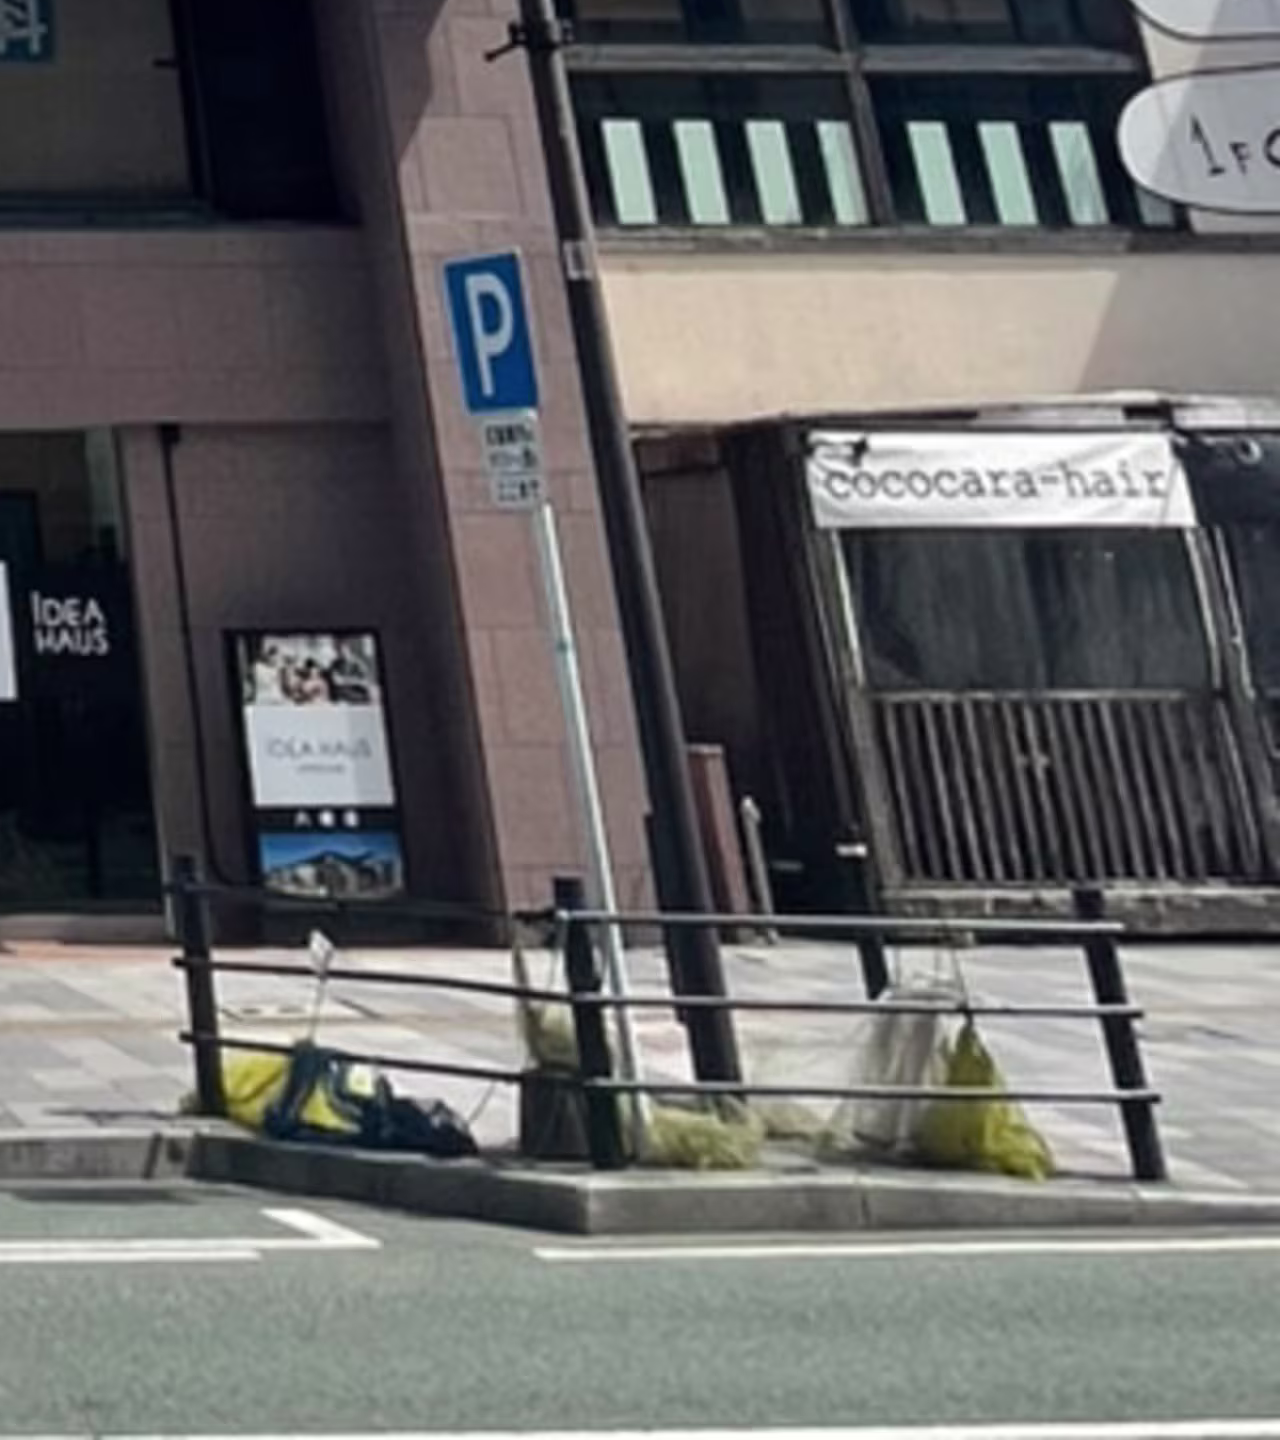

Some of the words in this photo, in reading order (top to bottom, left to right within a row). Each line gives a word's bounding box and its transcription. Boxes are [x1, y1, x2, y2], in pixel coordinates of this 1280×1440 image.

[465, 273, 513, 397] P
[825, 460, 1168, 499] cococara-hair
[30, 590, 106, 627] IDEA
[35, 627, 110, 656] HAUS
